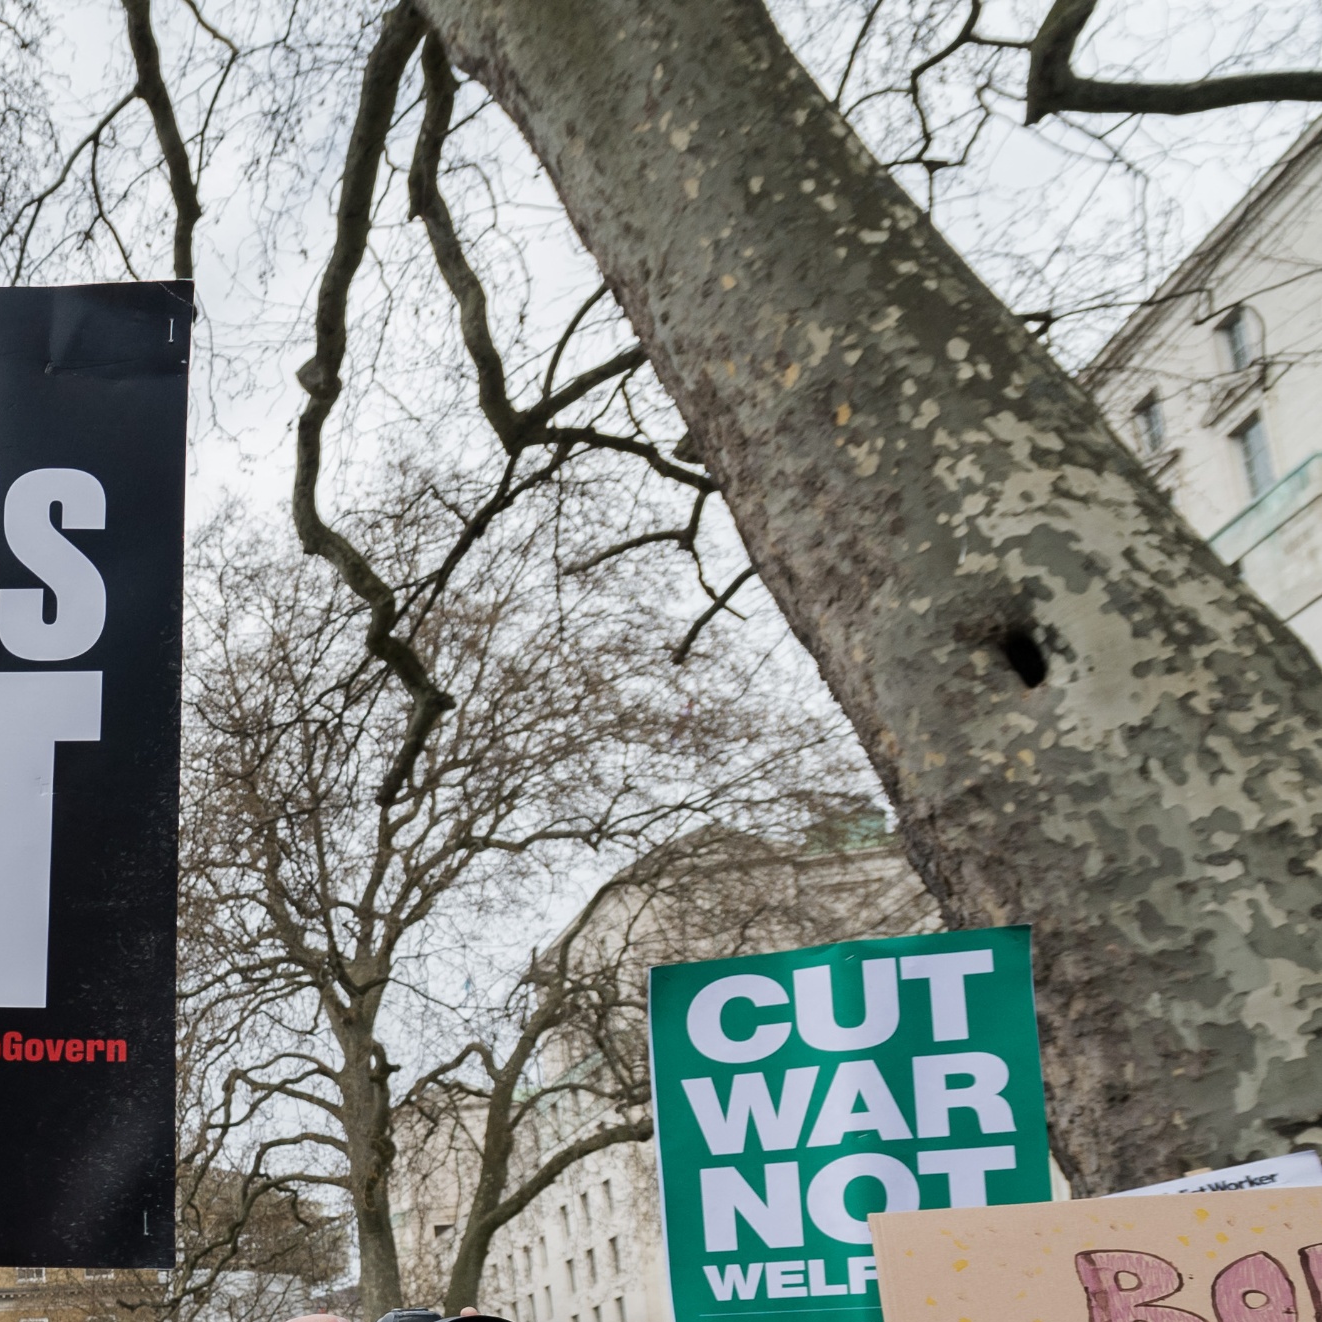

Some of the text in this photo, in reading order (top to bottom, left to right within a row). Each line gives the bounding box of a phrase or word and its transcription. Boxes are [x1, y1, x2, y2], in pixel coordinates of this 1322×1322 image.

[686, 950, 995, 1064] CUT
[681, 1051, 1018, 1156] WAR
[699, 1146, 1017, 1253] NOT
[702, 1256, 879, 1301] WELF
